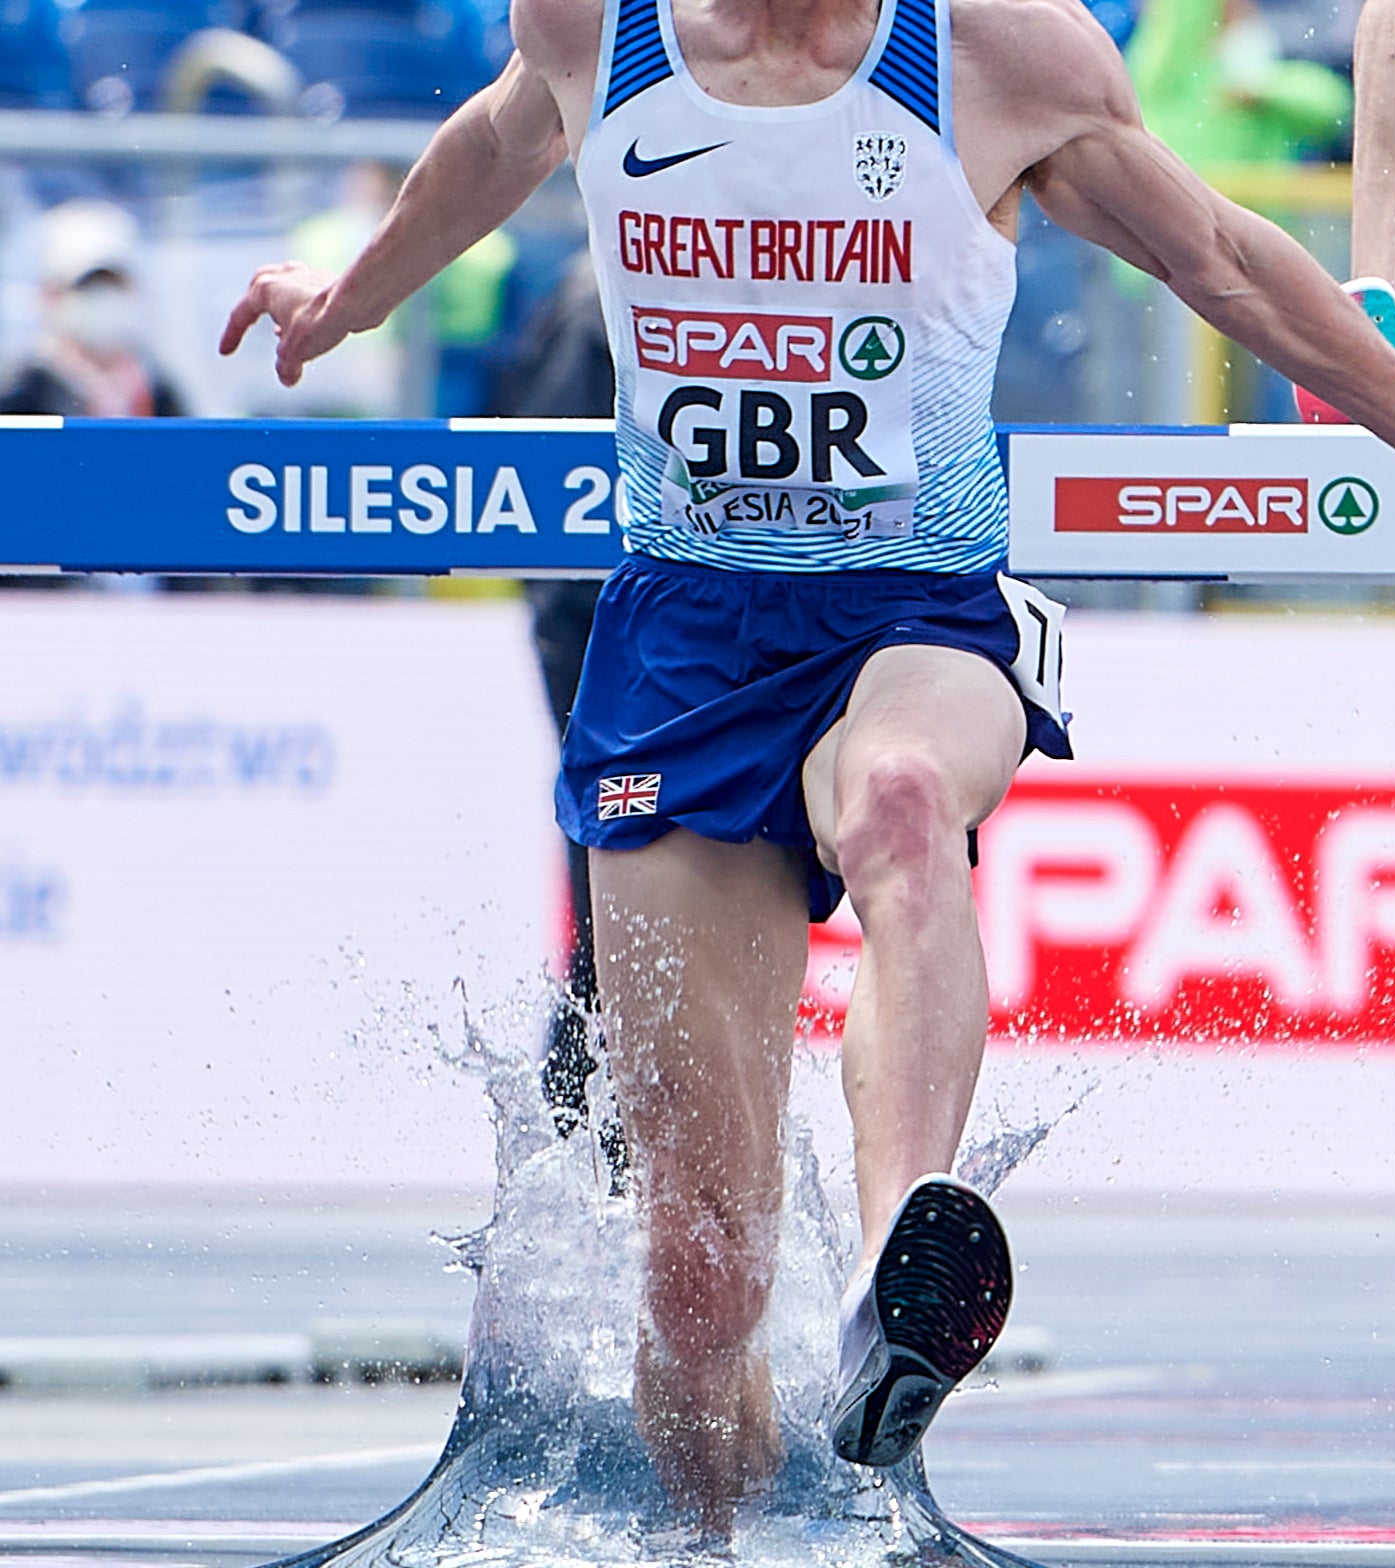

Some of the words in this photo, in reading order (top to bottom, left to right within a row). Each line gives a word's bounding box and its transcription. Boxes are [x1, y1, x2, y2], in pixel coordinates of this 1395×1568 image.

[619, 210, 743, 280] GREAT
[750, 218, 912, 284] BRITAIN
[637, 318, 826, 374] SPAR
[658, 385, 886, 482] GBR
[226, 463, 539, 534] SILESIA
[1117, 485, 1304, 527] SPAR
